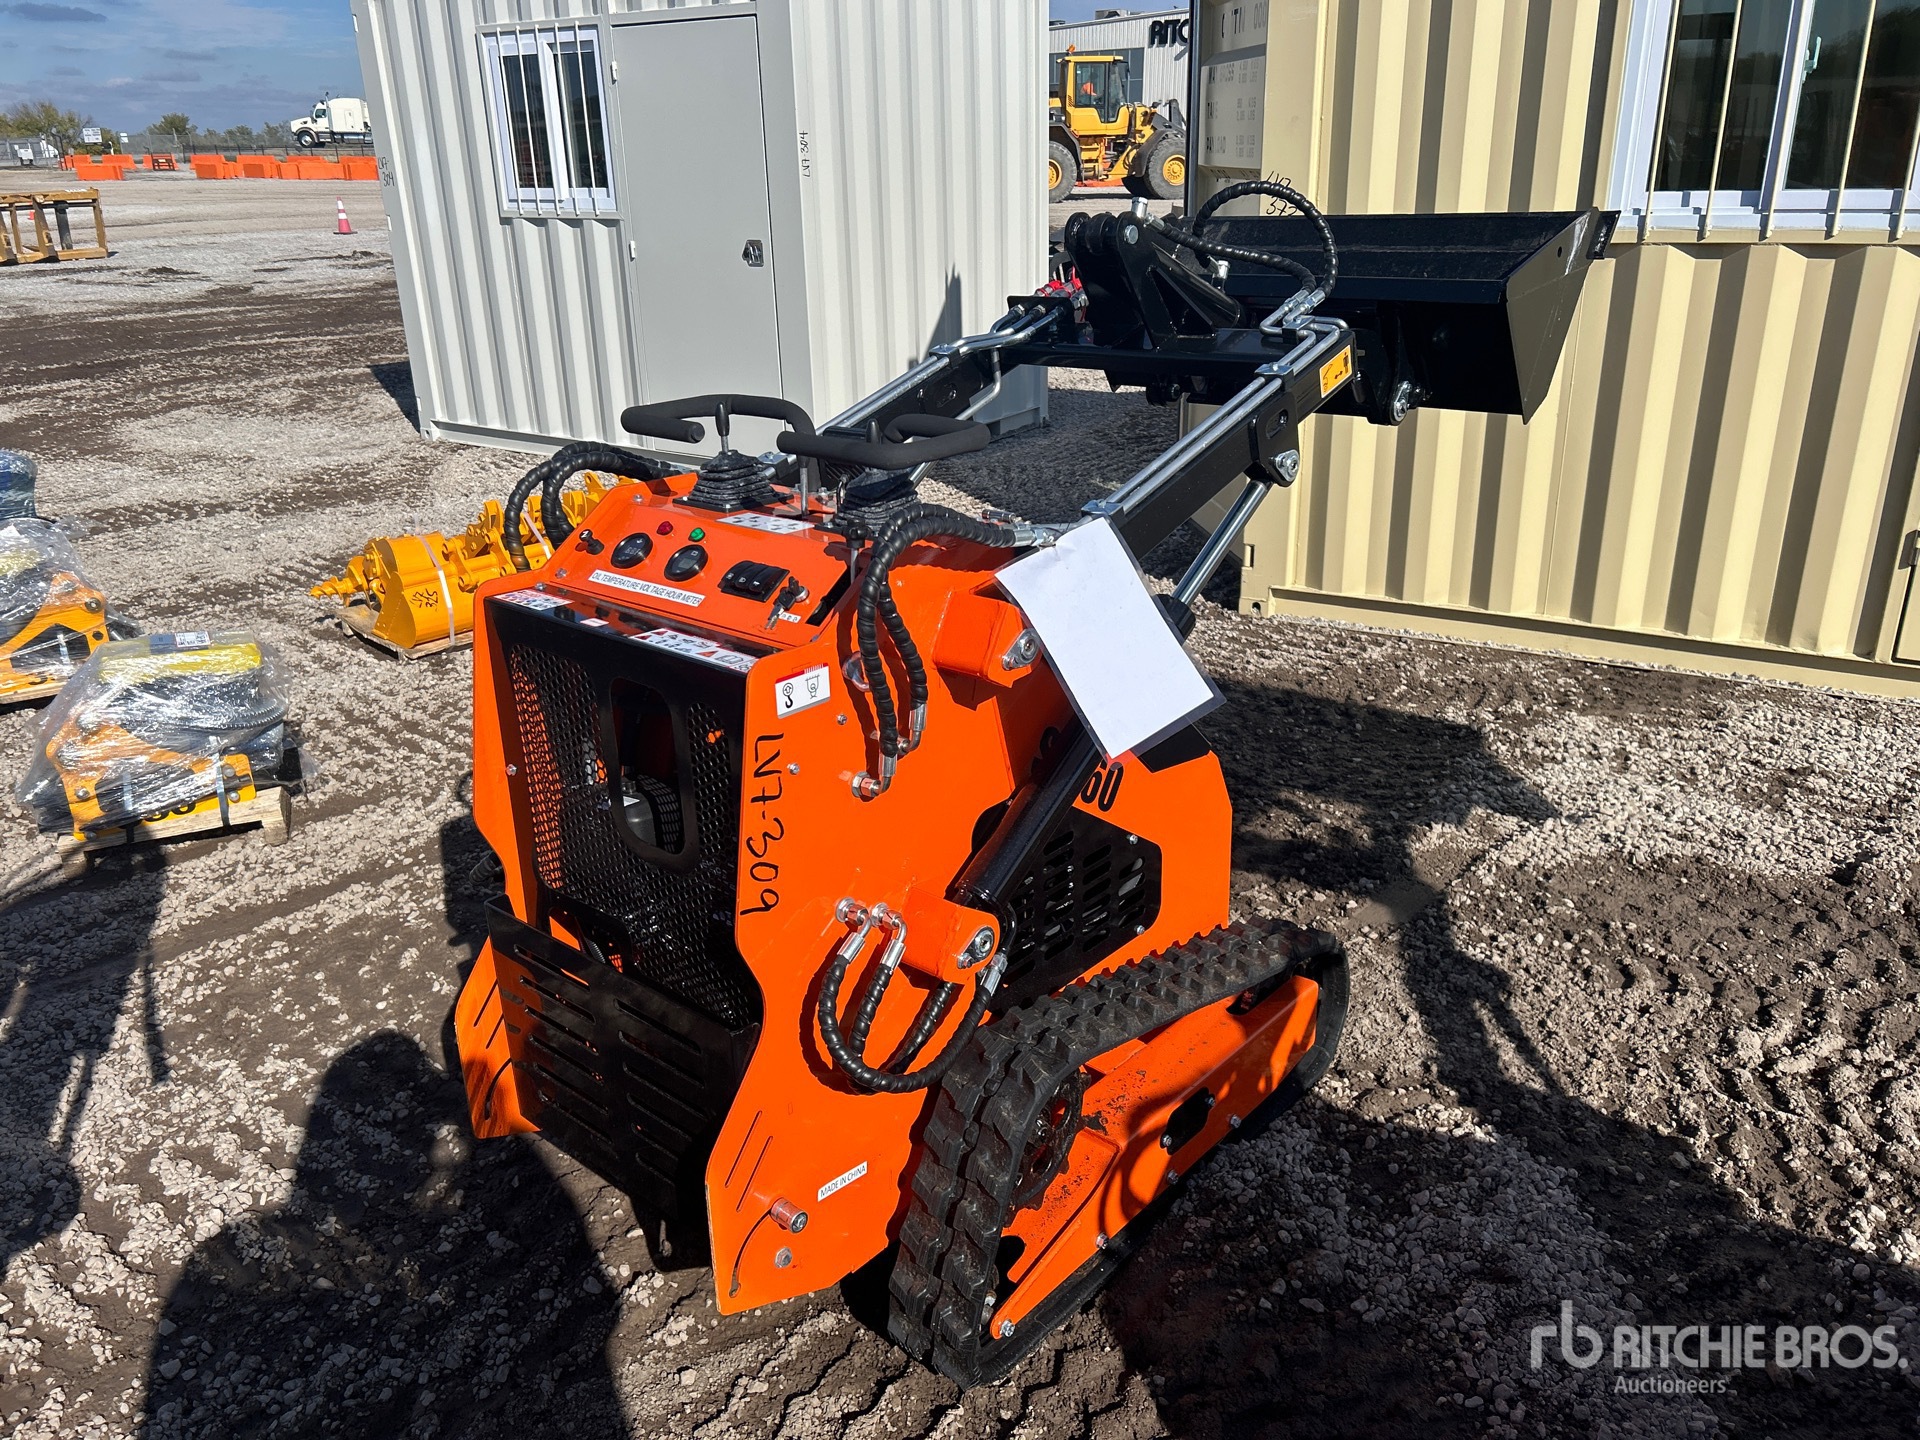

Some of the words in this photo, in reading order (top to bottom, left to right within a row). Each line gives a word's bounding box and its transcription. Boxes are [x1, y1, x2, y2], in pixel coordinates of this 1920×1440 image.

[600, 574, 641, 590] TEMPERATURE
[664, 589, 683, 600] HOUR
[681, 593, 702, 605] METER
[740, 732, 785, 916] LV7-309
[820, 1180, 839, 1198] MADE
[839, 1175, 847, 1186] IN
[847, 1164, 866, 1182] CHINA
